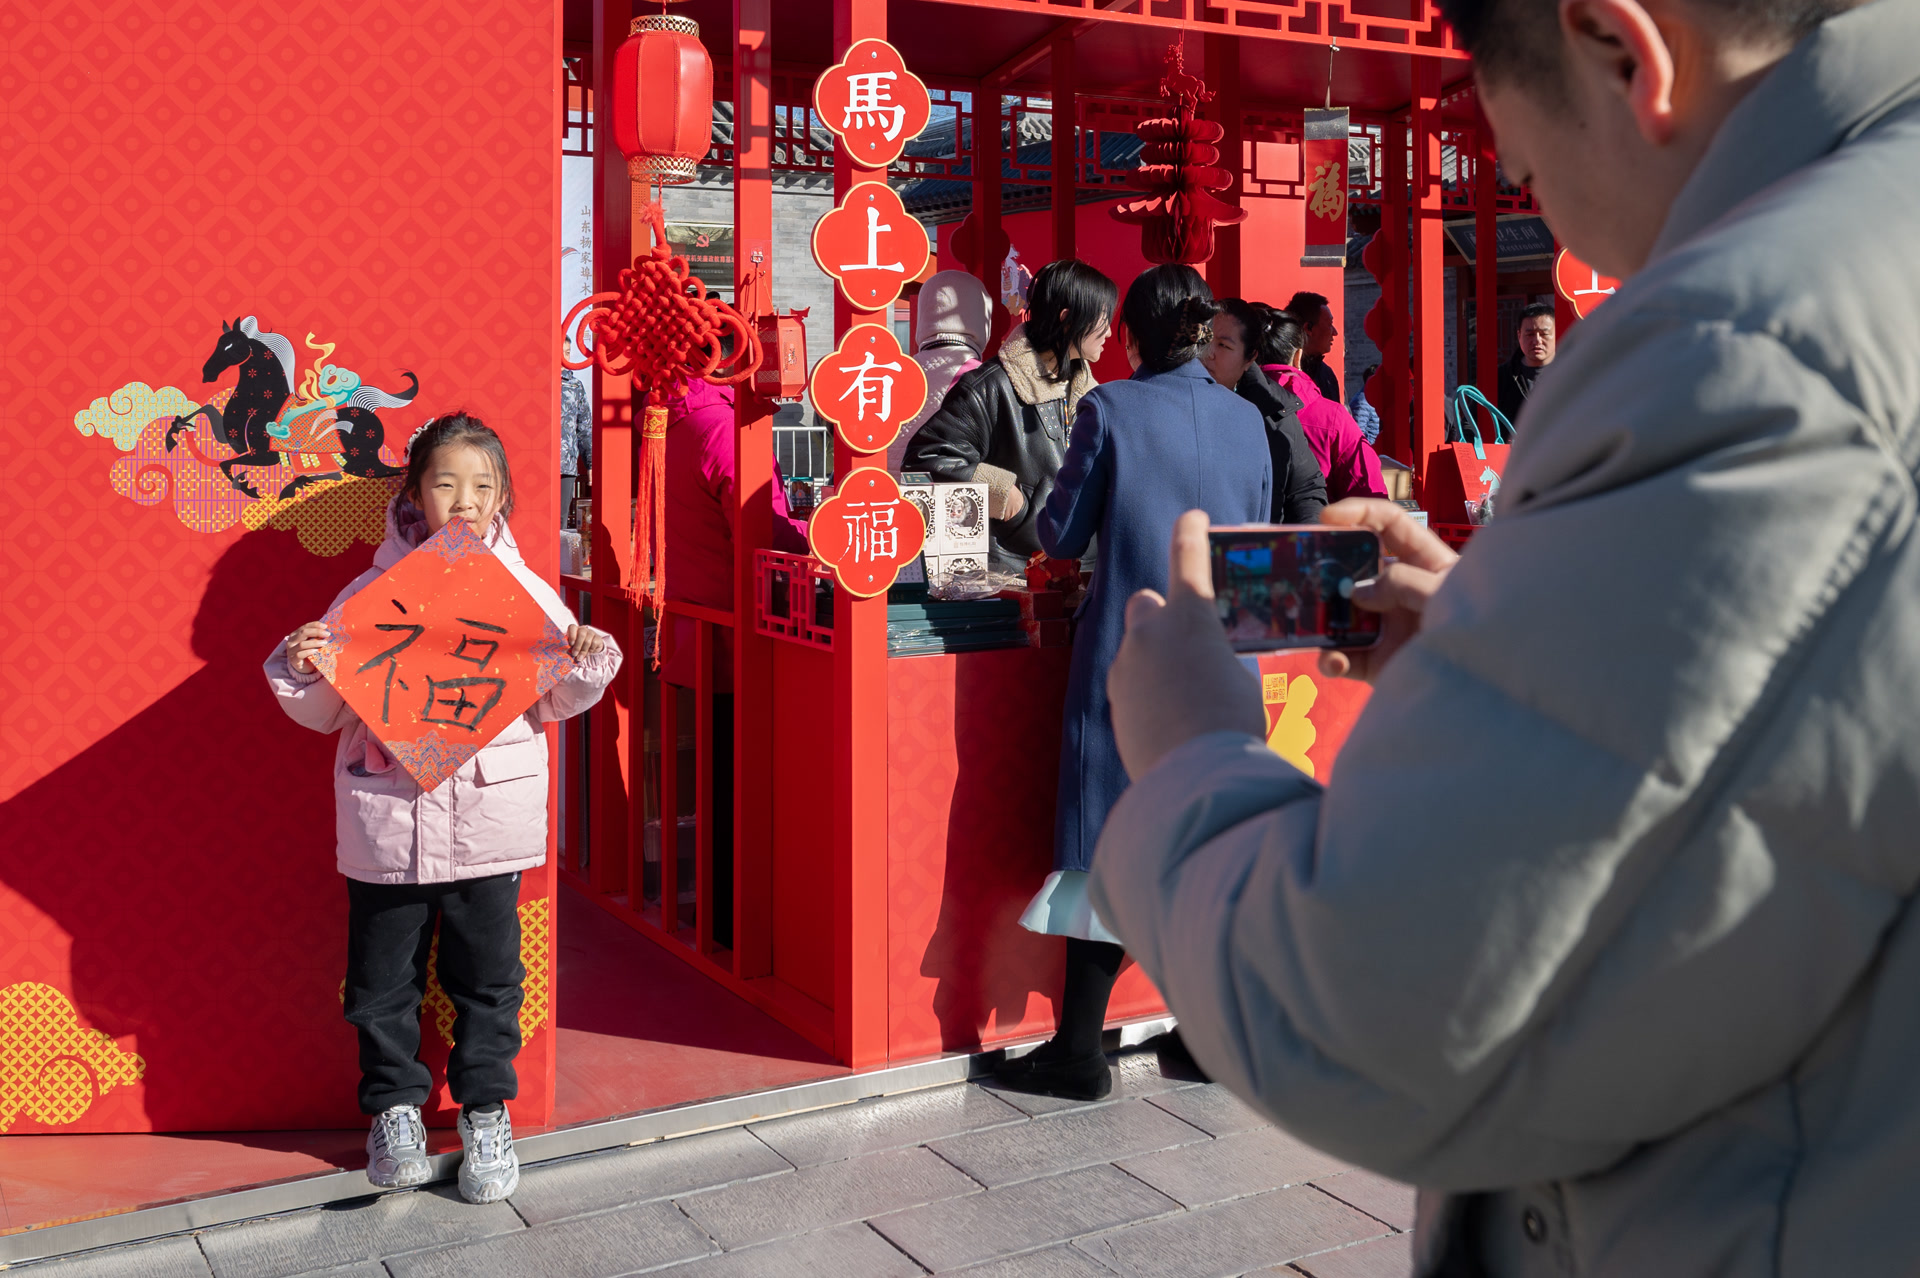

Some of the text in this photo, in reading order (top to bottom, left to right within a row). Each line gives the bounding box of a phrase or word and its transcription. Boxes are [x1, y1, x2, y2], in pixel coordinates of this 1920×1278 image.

[1308, 161, 1345, 223] 福
[580, 205, 592, 342] 山东杨家埠木画
[355, 599, 508, 733] 福
